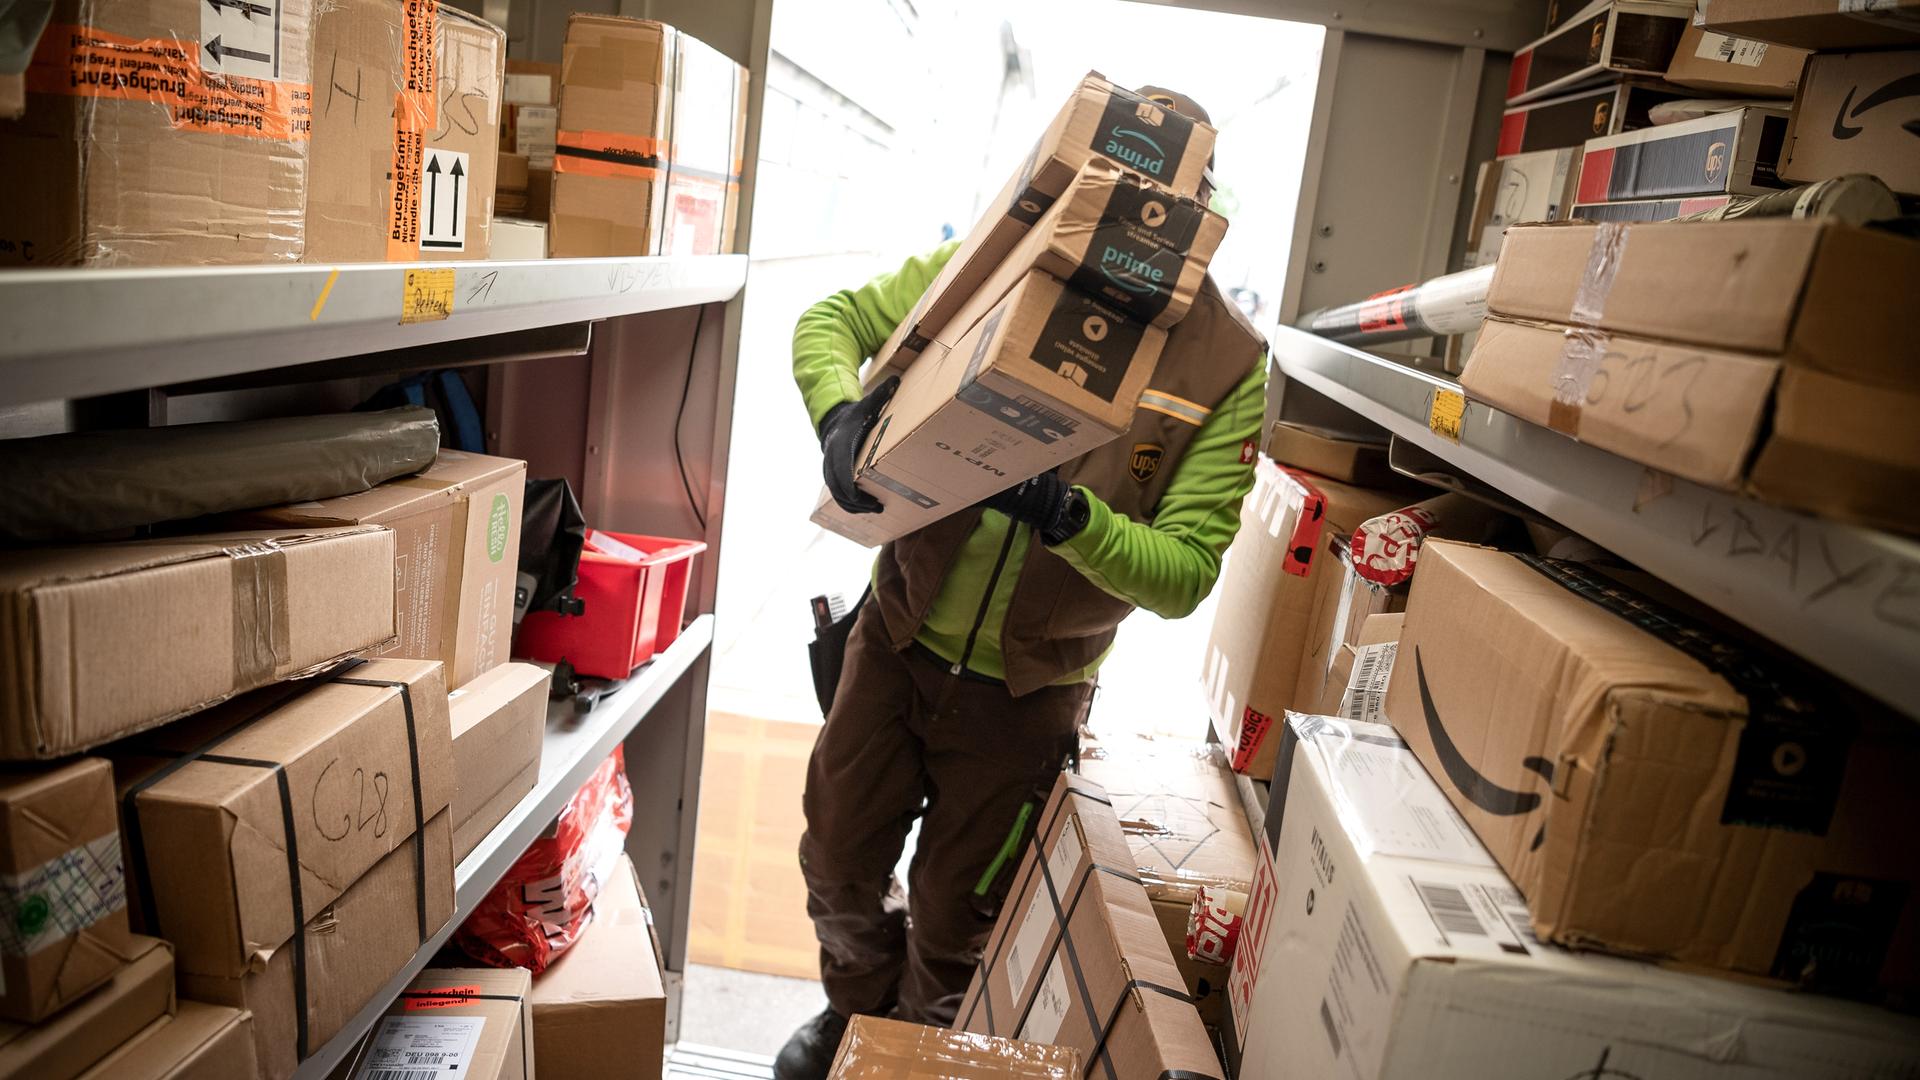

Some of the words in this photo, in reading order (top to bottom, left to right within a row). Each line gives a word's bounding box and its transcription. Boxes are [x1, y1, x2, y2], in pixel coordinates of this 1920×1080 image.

[70, 52, 116, 68] Fragile!
[407, 0, 418, 90] Bruchgefa
[120, 58, 161, 72] werfen!
[70, 70, 185, 97] Bruchgefahr!
[230, 81, 264, 98] Handle
[174, 106, 263, 130] Bruchgefahr!
[1106, 140, 1164, 174] prime
[392, 130, 406, 240] Bruchgefahr!
[410, 199, 418, 242] Handle
[1102, 246, 1164, 282] prime
[935, 441, 1006, 477] MP10
[1132, 454, 1158, 476] ups
[1311, 826, 1334, 884] VITALIS
